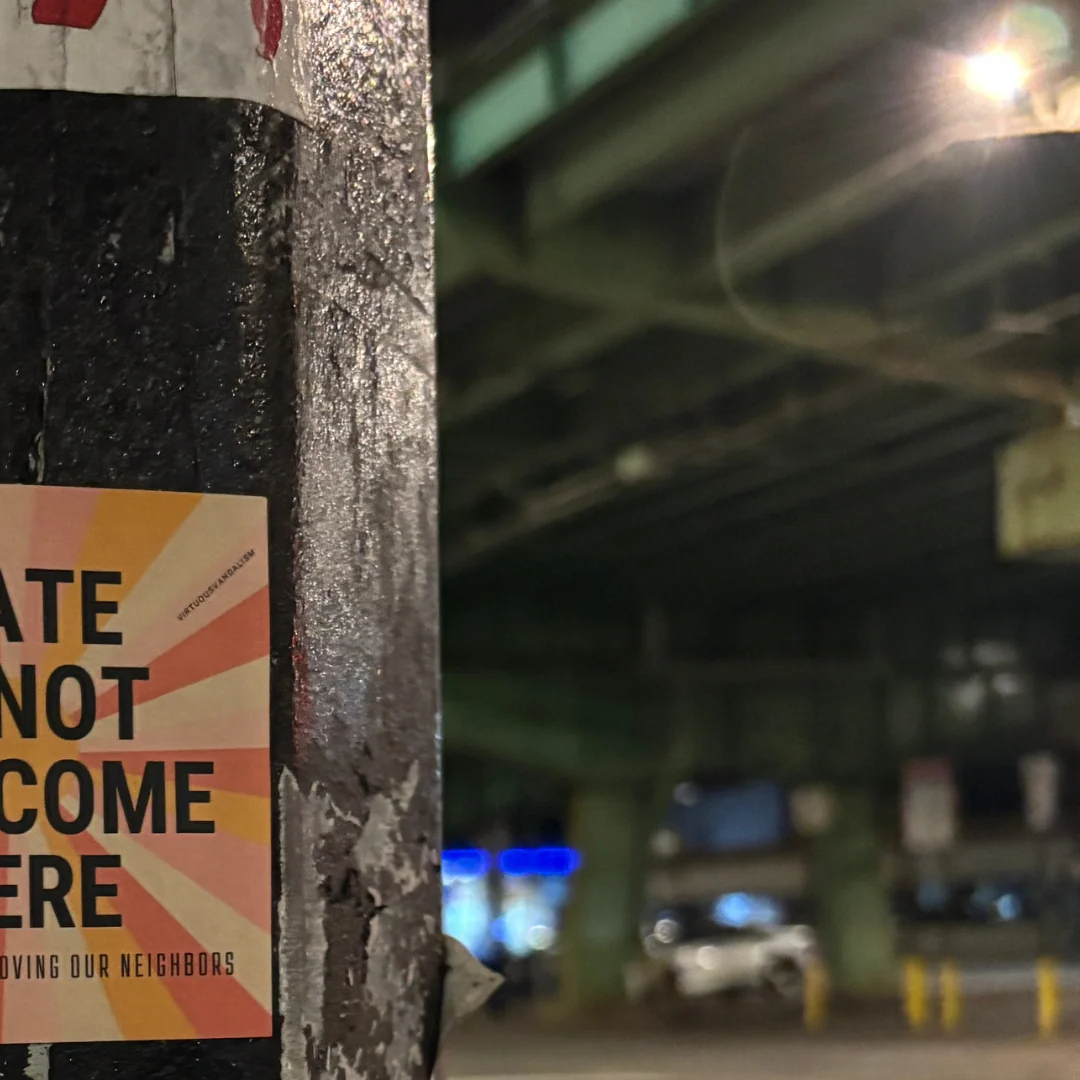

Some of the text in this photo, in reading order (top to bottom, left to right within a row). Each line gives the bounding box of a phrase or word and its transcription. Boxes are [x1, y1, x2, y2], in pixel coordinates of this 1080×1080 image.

[177, 548, 256, 621] VIRTUOUSVANDALISM
[70, 953, 110, 979] OUR
[120, 951, 236, 978] NEIGHBORS
